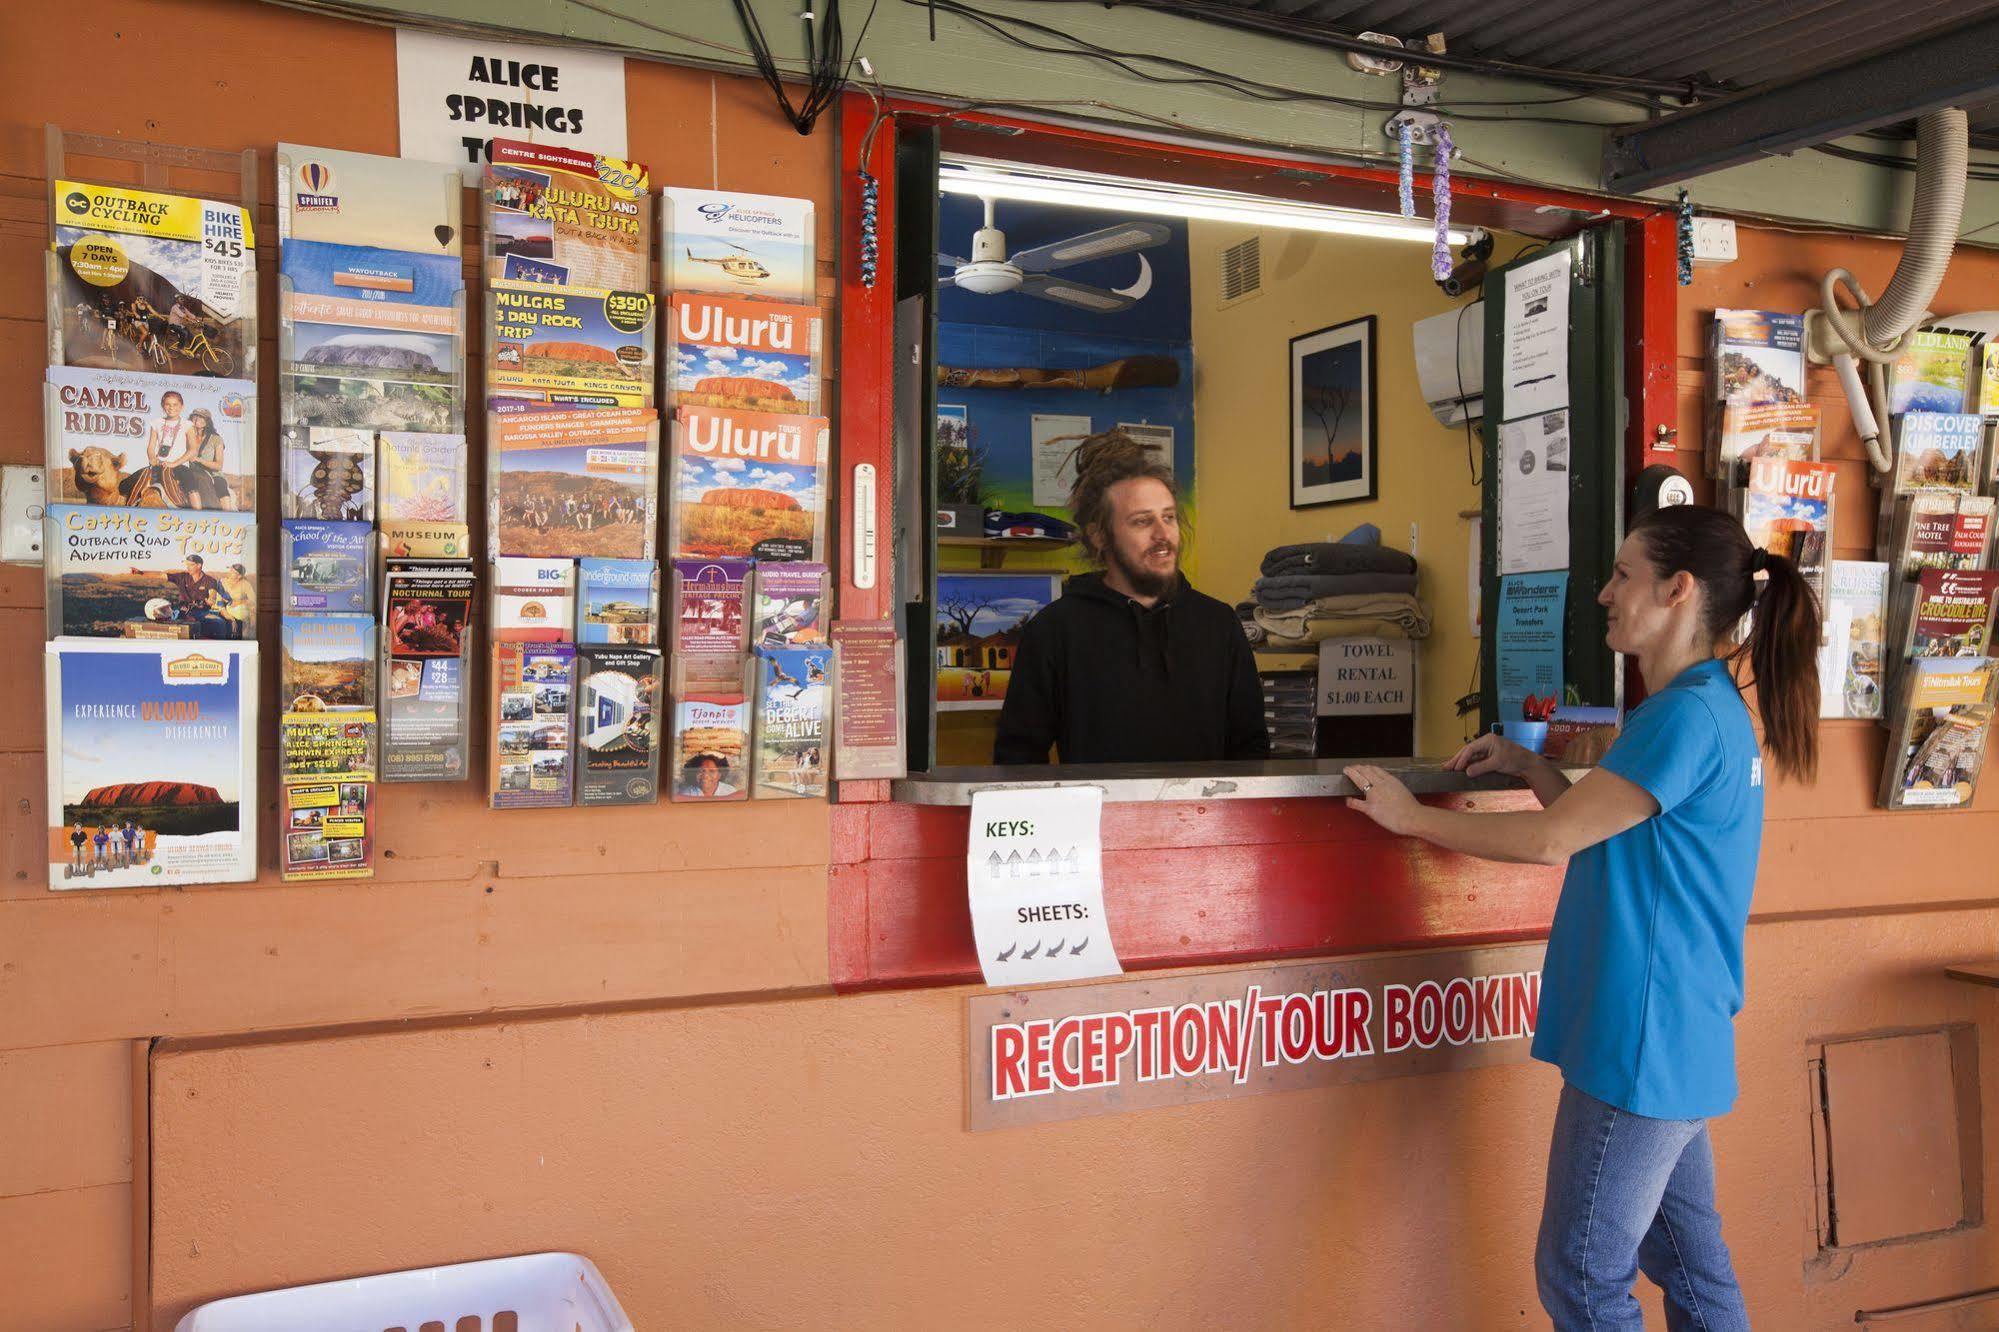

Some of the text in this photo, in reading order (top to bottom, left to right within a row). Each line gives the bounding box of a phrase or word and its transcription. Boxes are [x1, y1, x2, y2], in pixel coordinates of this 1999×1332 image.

[469, 56, 558, 92] ALICE
[446, 95, 583, 134] SPRINGS
[502, 148, 592, 168] CENTRE SIGHTSEEING
[94, 195, 169, 216] OUTBACK
[301, 196, 333, 206] SPINIFEX
[544, 187, 638, 215] ULURU AND
[91, 208, 161, 226] CYCLING
[204, 210, 241, 226] BIKE
[529, 204, 640, 234] KATA TJUTA
[728, 214, 783, 226] HELICOPTERS
[204, 223, 243, 240] HIRE
[557, 227, 576, 235] OUT
[586, 231, 607, 240] BACK
[86, 244, 113, 254] OPEN
[205, 238, 242, 258] $45
[91, 253, 117, 263] DAYS
[348, 267, 398, 278] WAYOUTBACK
[496, 293, 566, 311] MULGAS
[609, 295, 649, 312] $390
[496, 310, 583, 330] 3 DAY ROCK
[769, 313, 793, 323] TOURS
[496, 325, 534, 340] TRIP
[553, 379, 576, 387] TJUTA
[611, 384, 642, 392] CANYON
[60, 385, 148, 412] CAMEL
[579, 396, 615, 405] INCLUDED
[497, 405, 525, 413] 2017-18
[541, 409, 642, 422] ISLAND GREAT OCEAN ROAD
[64, 411, 144, 437] RIDES
[519, 422, 554, 432] FLINDERS
[555, 421, 585, 430] RANGES
[1905, 415, 1980, 433] DISCOVER
[504, 426, 621, 442] BAROSSA VALLEY OUTBACK RED
[66, 511, 246, 539] Cattle Station
[1932, 521, 1949, 531] TREE
[68, 534, 171, 547] OUTBACK QUAD
[290, 530, 348, 544] School of the
[392, 530, 455, 540] MUSEUM
[1916, 531, 1943, 540] MOTEL
[176, 536, 243, 555] Tours
[70, 549, 151, 561] ADVENTURES
[393, 590, 471, 598] NOCTURNAL TOUR
[1514, 584, 1560, 596] Wanderer
[1513, 606, 1533, 614] Desert
[1920, 602, 1973, 618] CROCODILE
[1342, 644, 1394, 658] TOWEL
[432, 660, 447, 671] $44
[432, 672, 447, 683] $28
[1337, 668, 1396, 681] RENTAL
[1327, 691, 1403, 705] $1.00 EACH
[75, 704, 136, 719] EXPERIENCE
[691, 708, 726, 719] Tjanpi
[767, 704, 819, 724] DESERT
[165, 725, 228, 739] DIFFERENTLY
[287, 727, 338, 737] MULGAS
[785, 720, 822, 738] ALIVE
[286, 740, 310, 749] ALICE
[312, 739, 354, 748] SPRINGS
[286, 747, 364, 757] DARWIN EXPRESS
[289, 761, 313, 769] JUST
[986, 820, 1034, 838] KEYS:
[1018, 903, 1088, 923] SHEETS:
[992, 985, 1373, 1100] RECEPTION/TOUR
